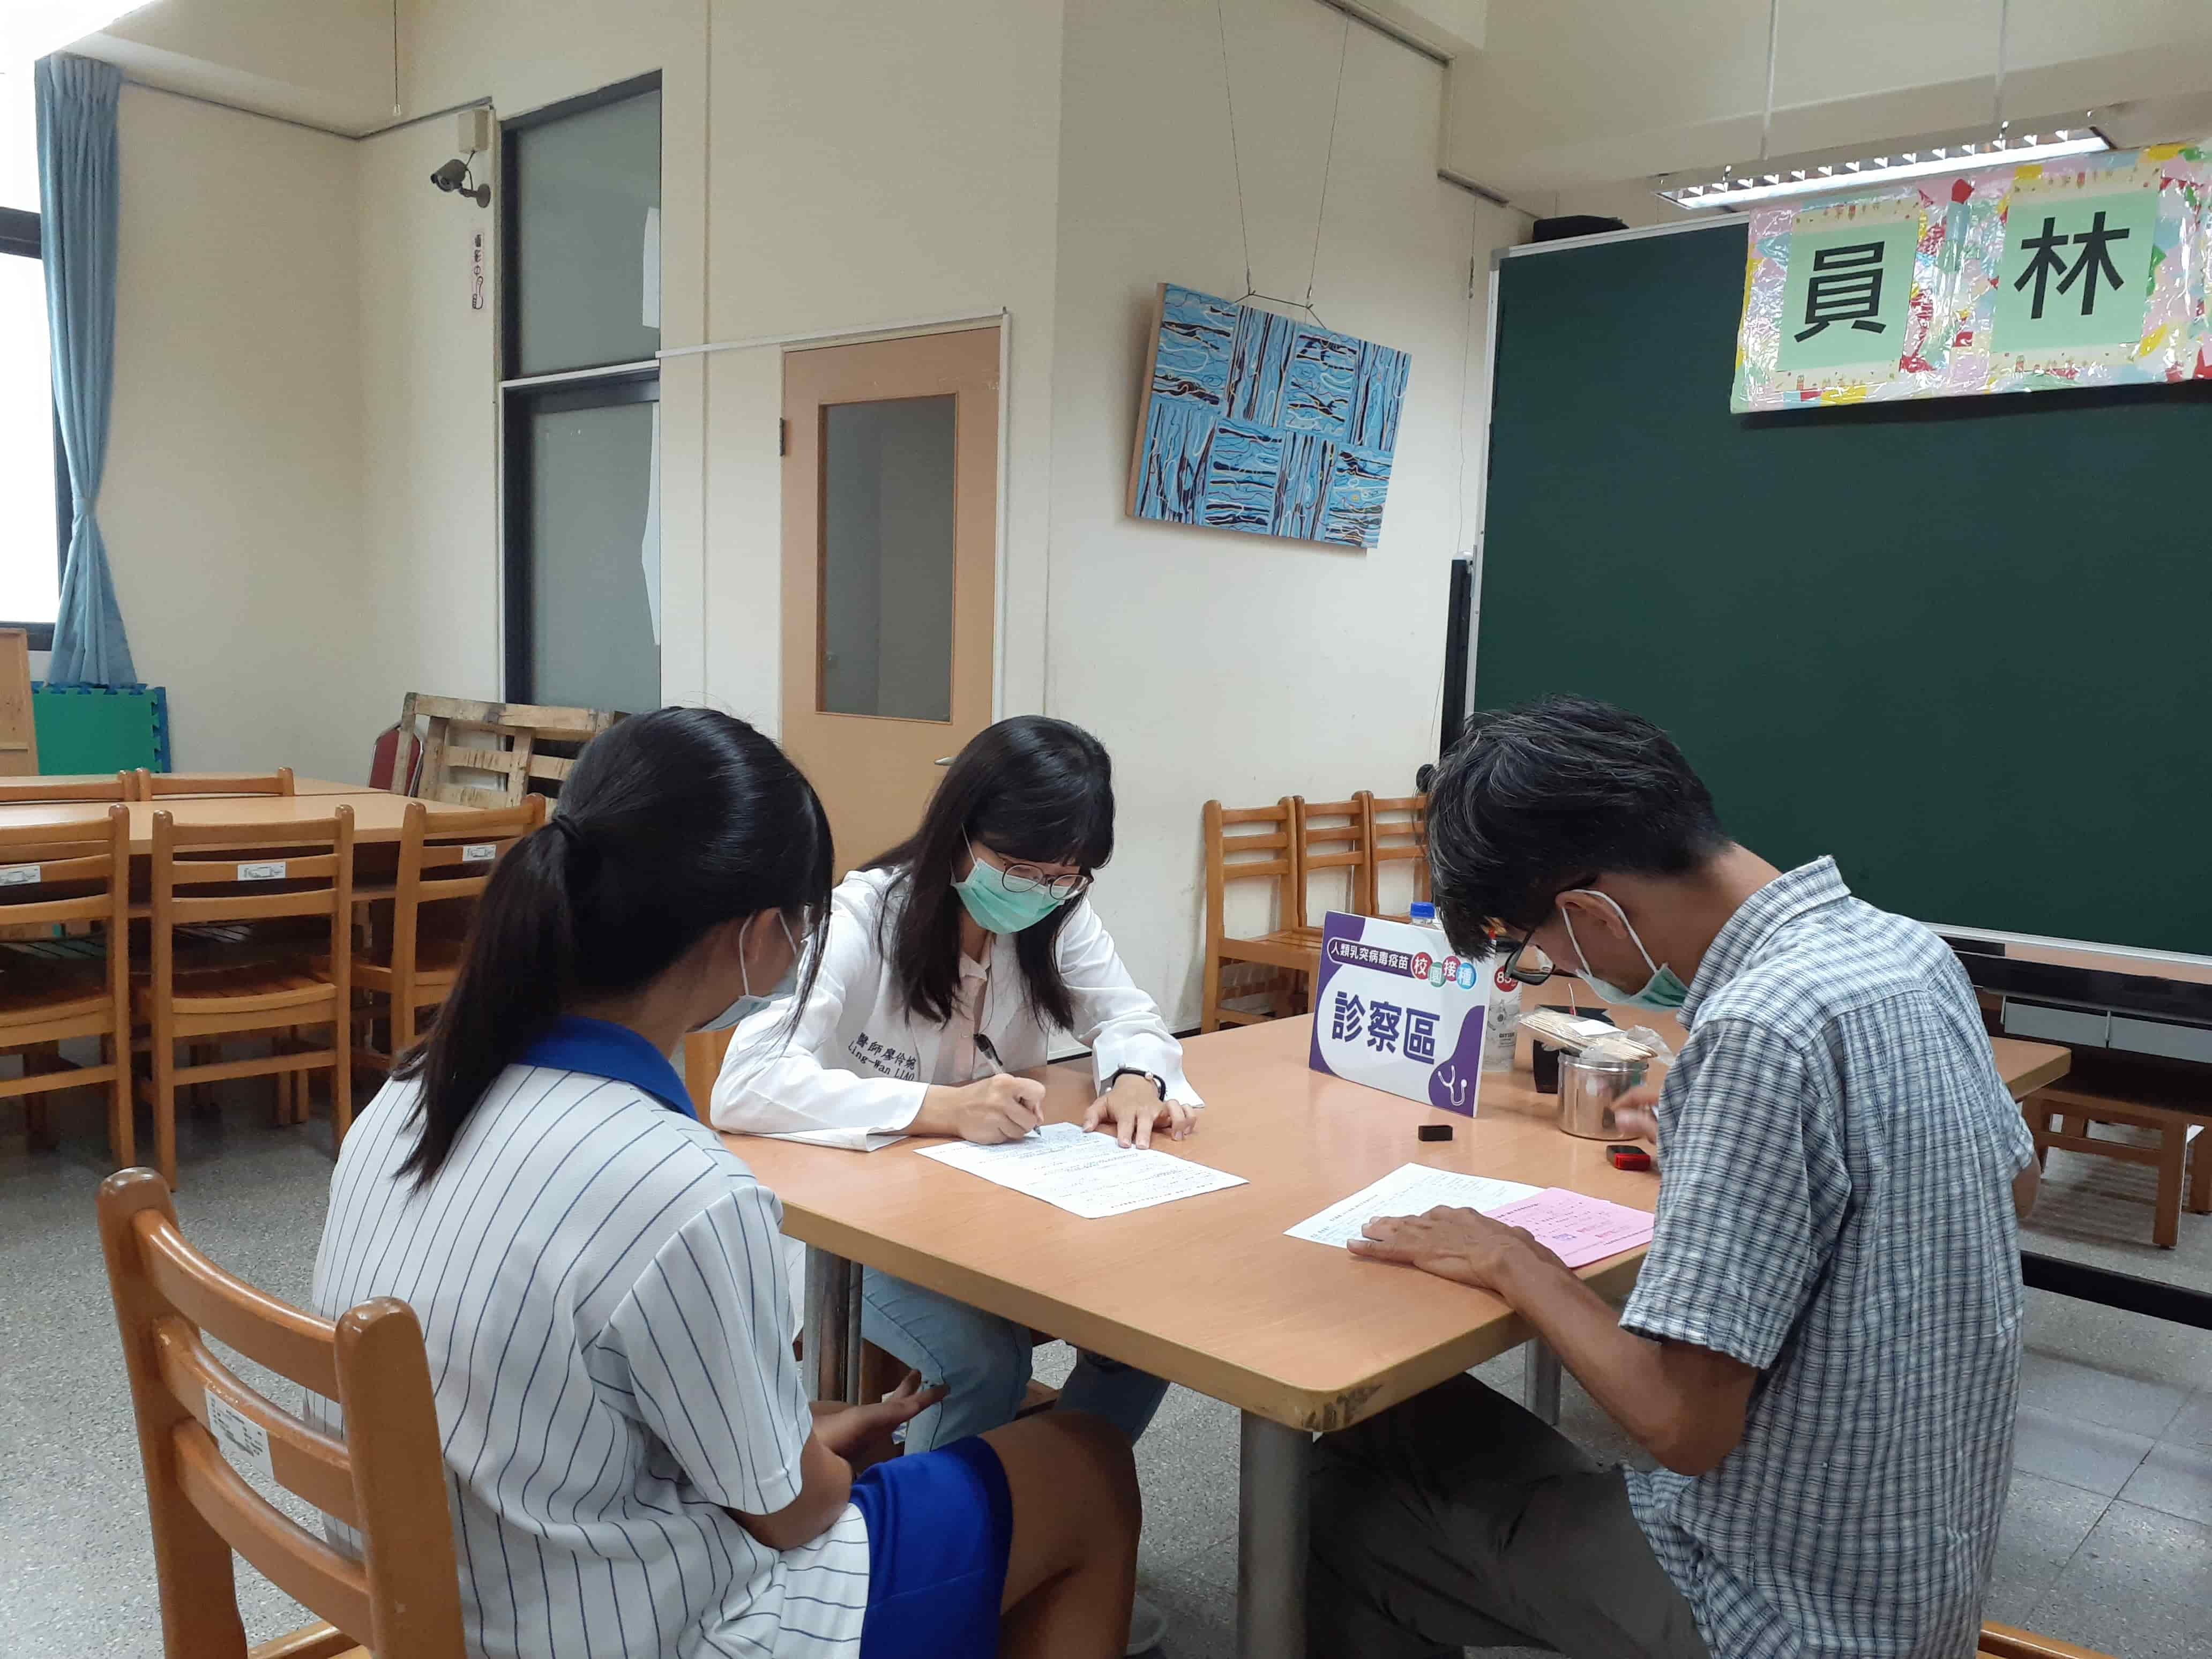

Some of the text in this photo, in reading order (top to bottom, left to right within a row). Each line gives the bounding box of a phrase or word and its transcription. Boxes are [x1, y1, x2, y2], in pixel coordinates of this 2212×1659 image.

[1793, 211, 2130, 343] 員 林
[1331, 941, 1409, 970] 人類乳突病毒疫苗
[1332, 990, 1441, 1065] 診察區
